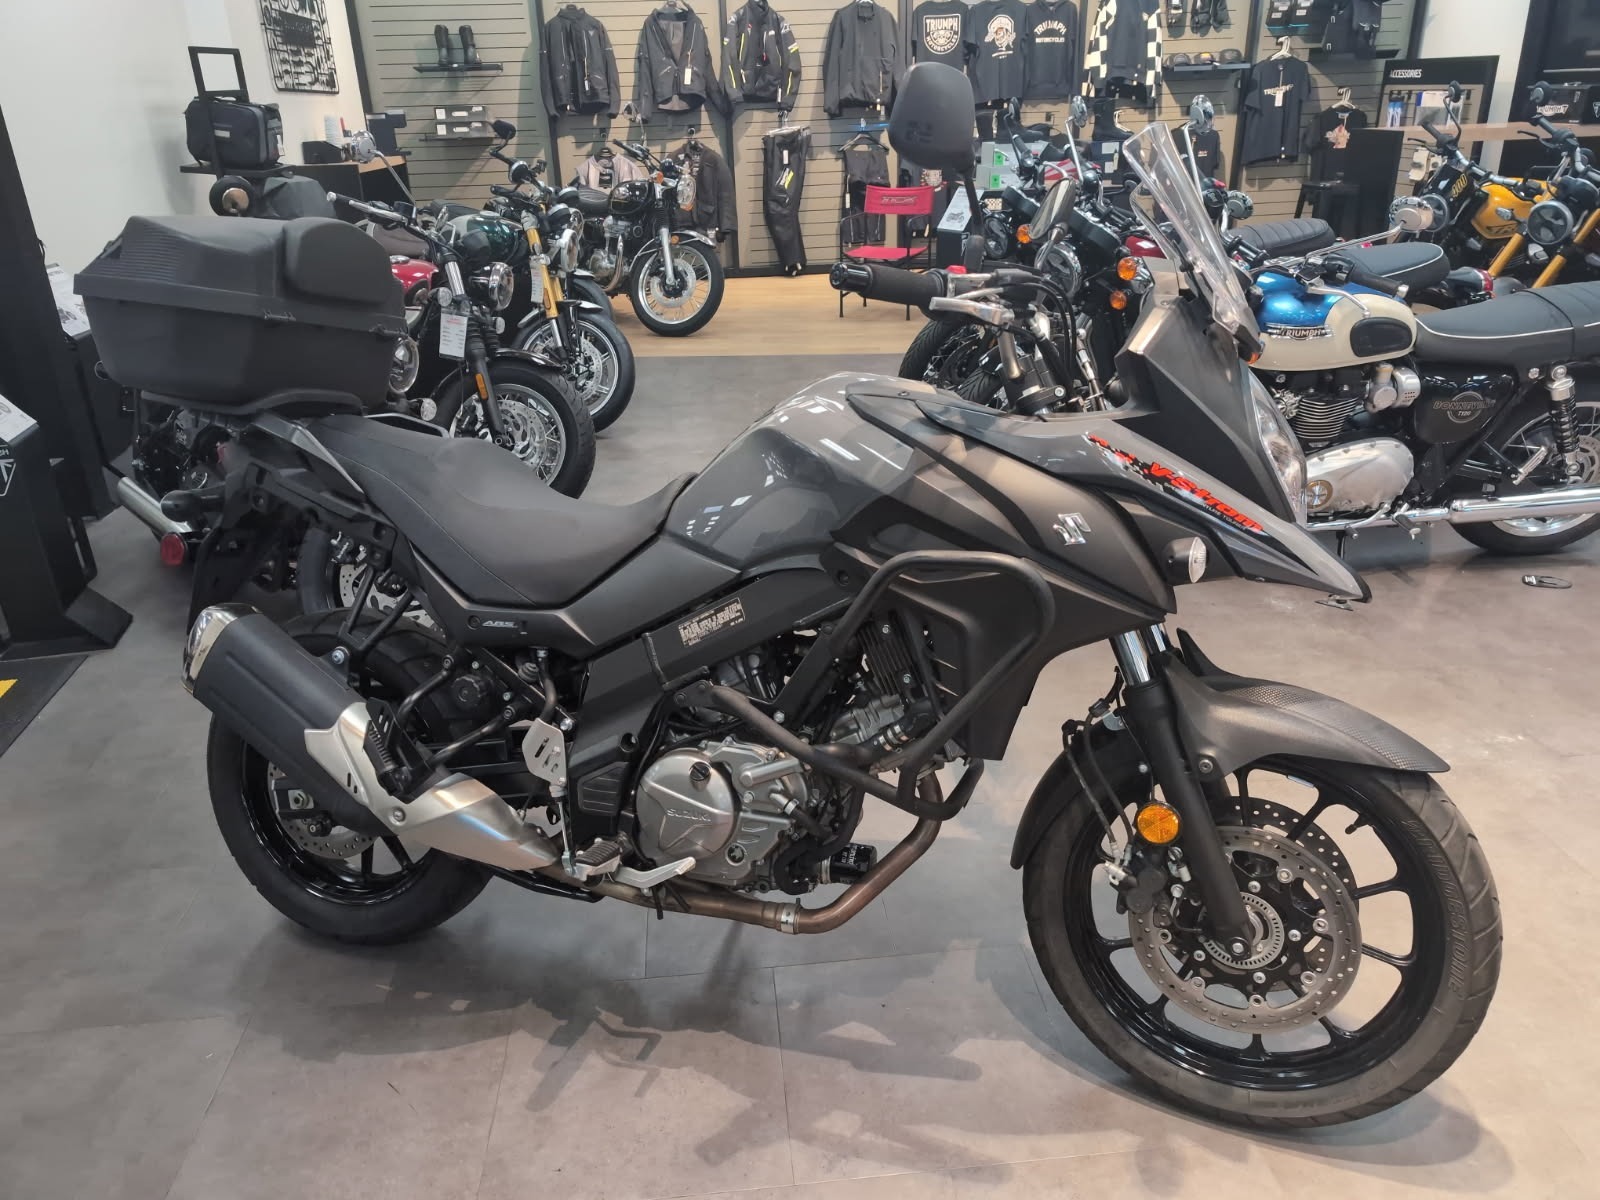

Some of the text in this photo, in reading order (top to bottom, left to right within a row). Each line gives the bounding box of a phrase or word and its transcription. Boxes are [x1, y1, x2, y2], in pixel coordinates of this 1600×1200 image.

[926, 19, 958, 31] TRIUMPH
[1034, 20, 1067, 35] TRIUMPH
[926, 36, 957, 52] MOTORCYCLES
[1390, 69, 1422, 78] ACCESSORIES
[1281, 327, 1321, 338] TRIUMPH
[666, 808, 712, 822] SUZUKI
